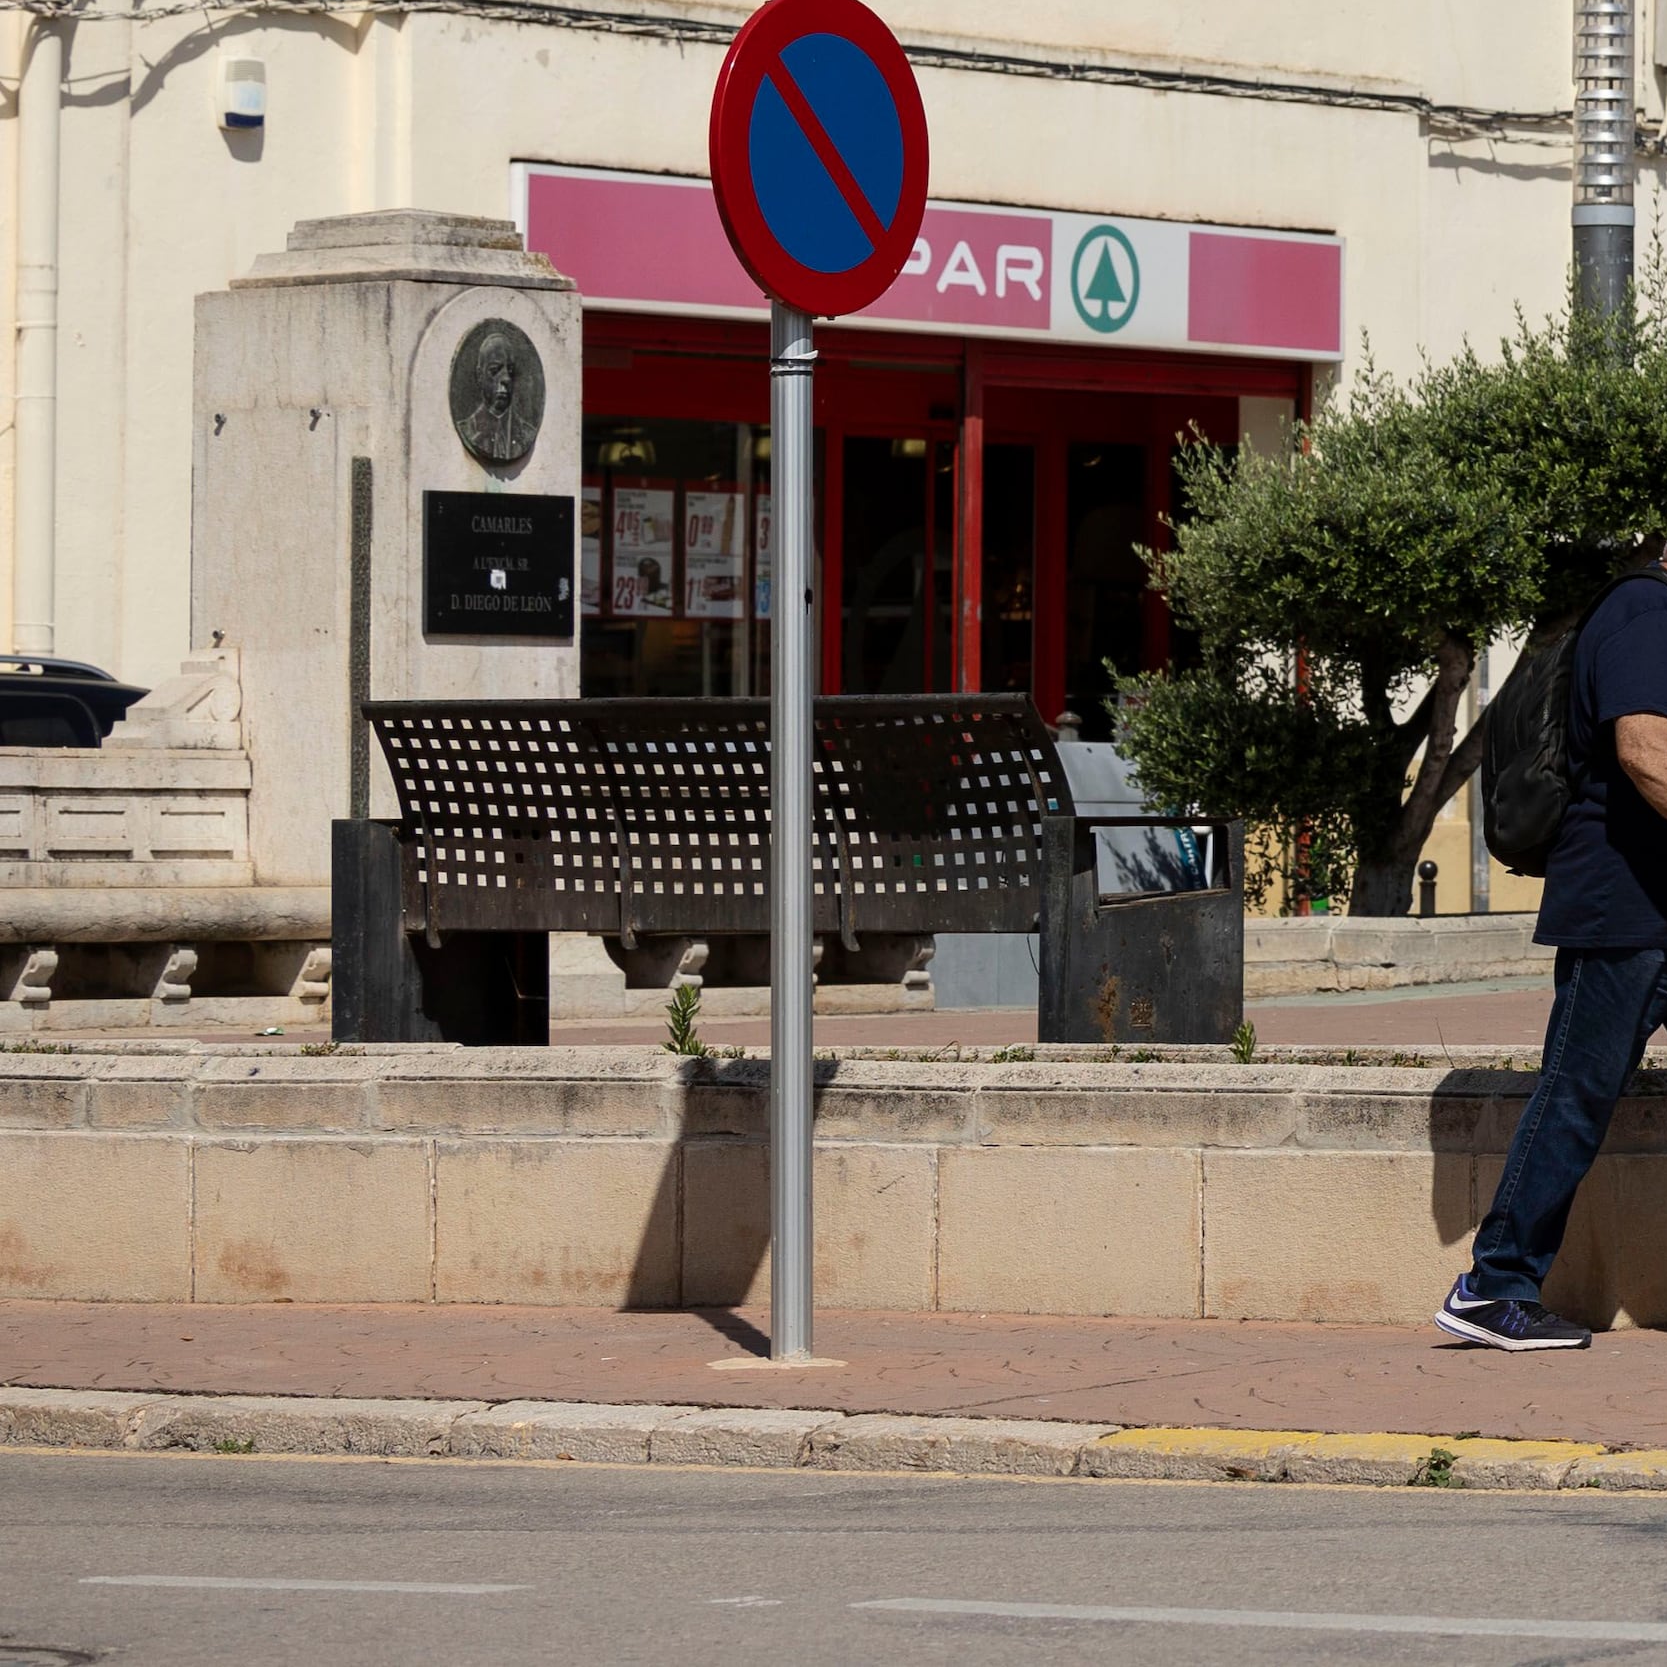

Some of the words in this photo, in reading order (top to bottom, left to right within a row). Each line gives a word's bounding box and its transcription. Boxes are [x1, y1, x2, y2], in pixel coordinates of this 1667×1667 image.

[899, 237, 1044, 302] PAR
[471, 515, 533, 534] CAMARLES
[464, 594, 500, 611] DIEGO
[503, 595, 519, 612] DE
[520, 592, 552, 612] LEÓN
